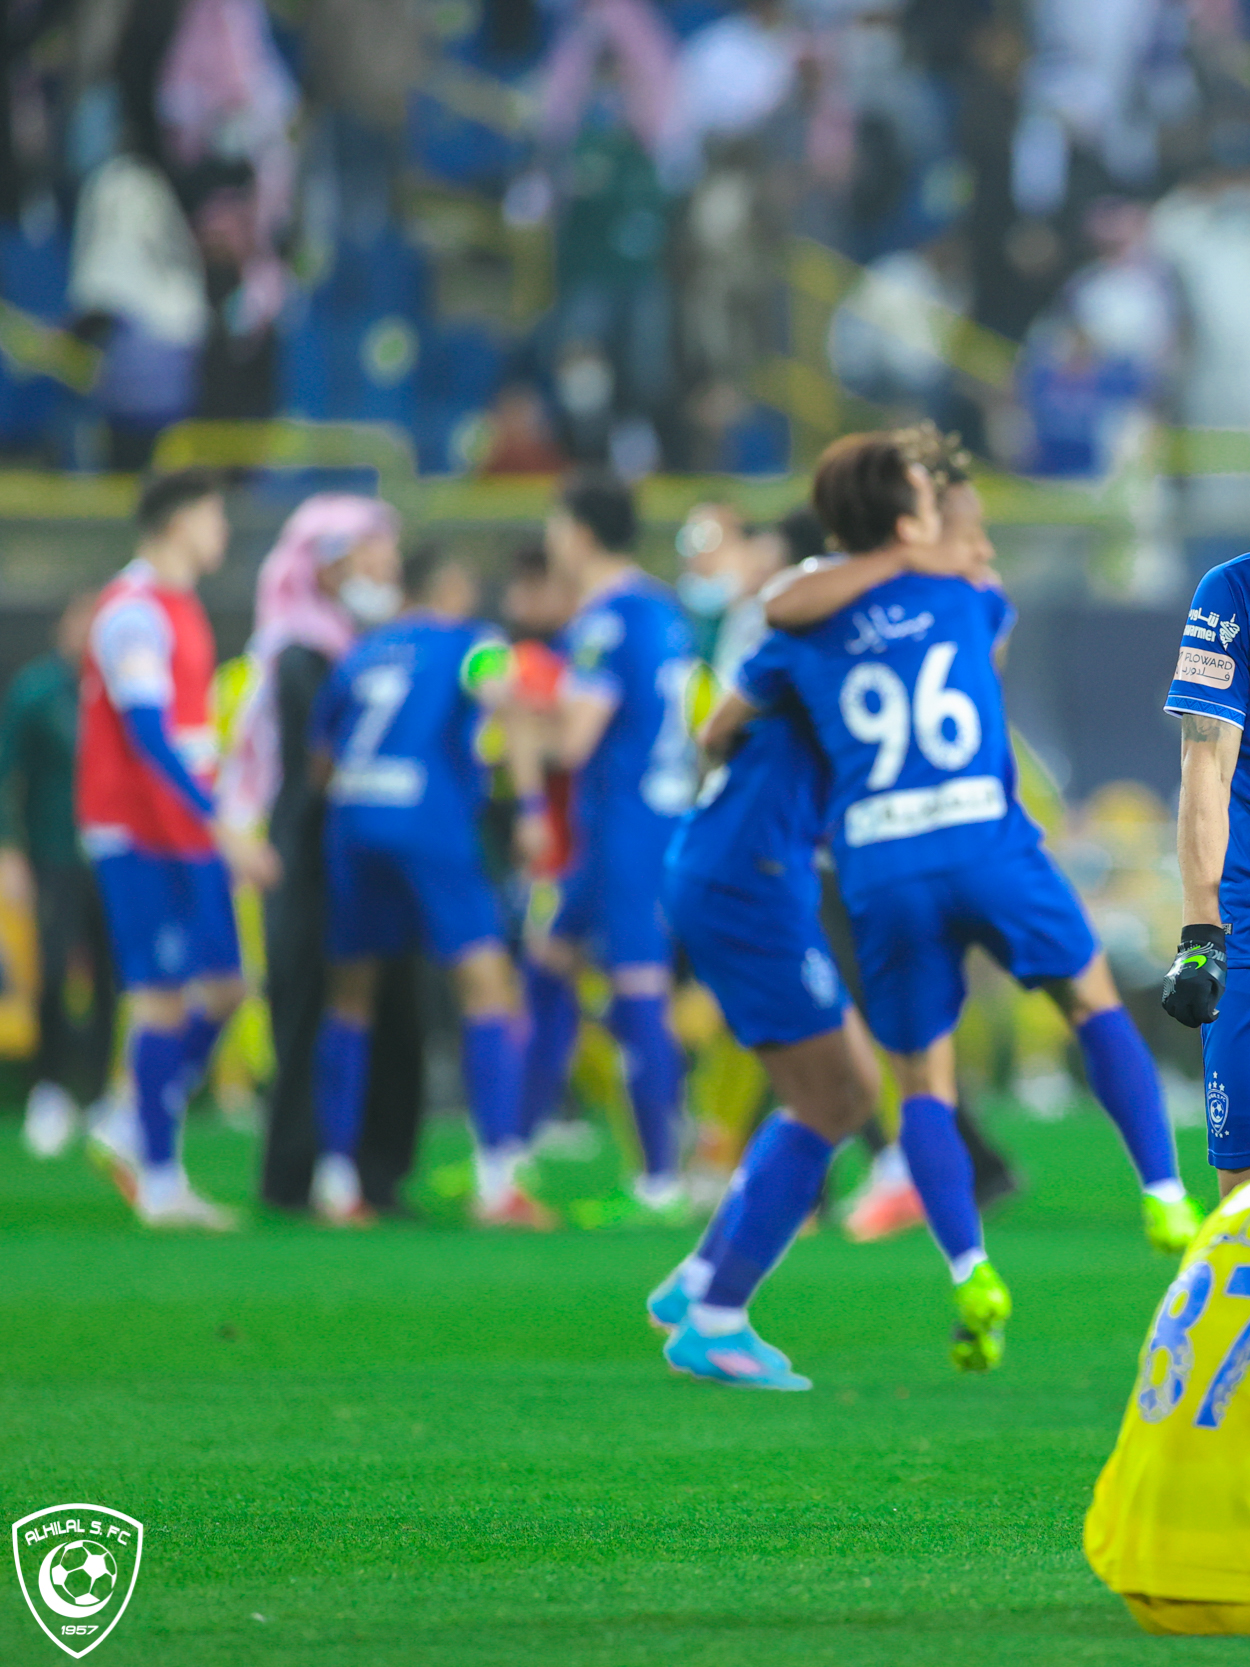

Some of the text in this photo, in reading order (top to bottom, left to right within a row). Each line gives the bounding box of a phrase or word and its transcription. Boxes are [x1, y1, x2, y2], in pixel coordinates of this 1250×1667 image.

[1183, 624, 1217, 643] warmer
[1184, 652, 1233, 671] FLOWARD
[838, 640, 982, 791] 96
